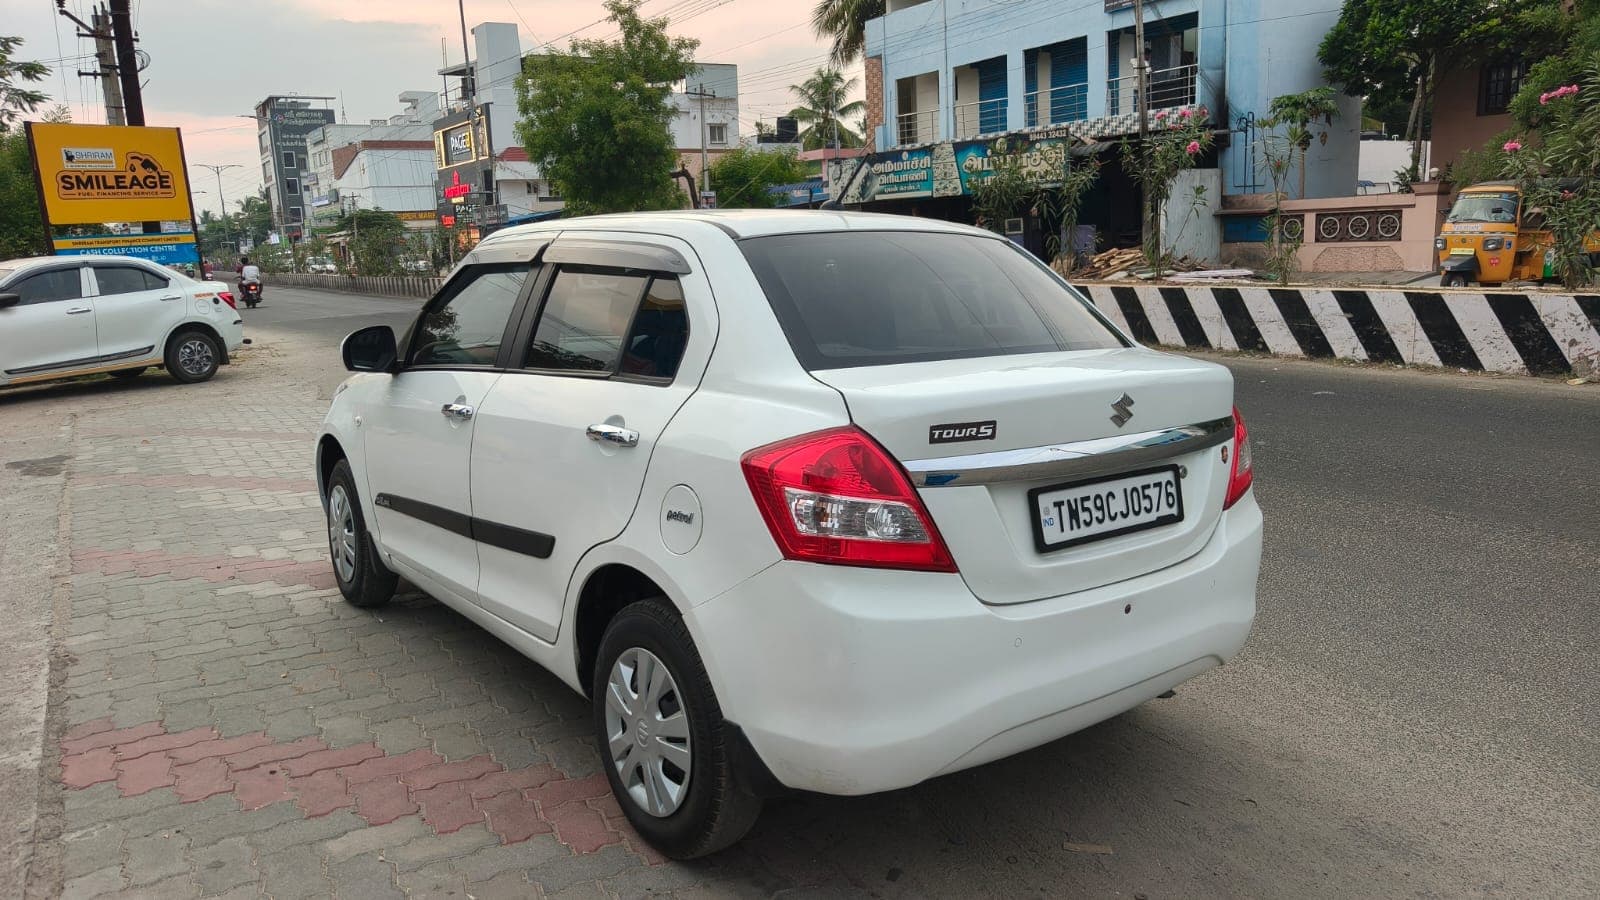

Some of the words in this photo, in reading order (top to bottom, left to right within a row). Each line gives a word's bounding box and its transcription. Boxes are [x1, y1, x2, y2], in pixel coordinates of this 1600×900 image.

[75, 151, 113, 160] SHRIRAM
[871, 156, 931, 174] அம்மாச்சி
[60, 174, 172, 190] SMILEAGE
[102, 246, 149, 255] COLLECTION
[1042, 517, 1055, 528] IND
[1053, 479, 1176, 533] TN59CJ0576
[666, 509, 694, 524] petrol
